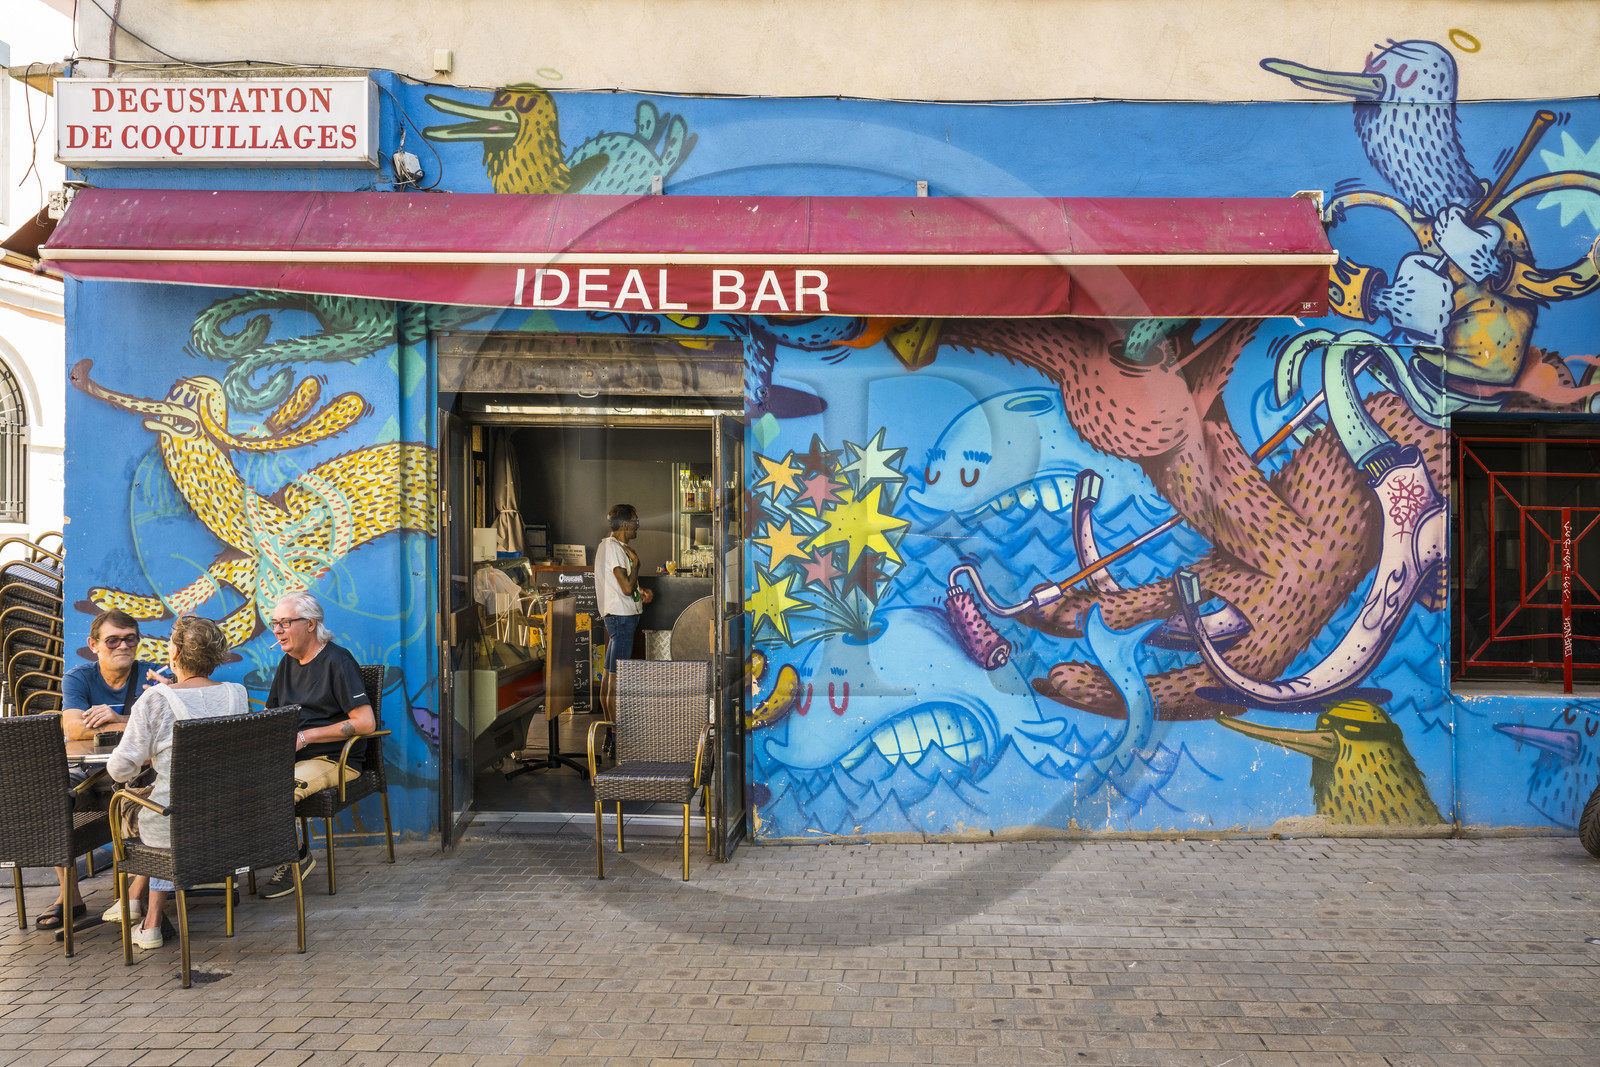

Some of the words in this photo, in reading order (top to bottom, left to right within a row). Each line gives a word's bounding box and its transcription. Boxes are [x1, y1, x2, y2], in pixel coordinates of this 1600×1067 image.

[91, 87, 332, 113] DEGUSTATION
[66, 124, 112, 149] DE
[121, 124, 357, 156] COQUILLAGES
[513, 268, 688, 311] IDEAL
[711, 269, 831, 312] BAR
